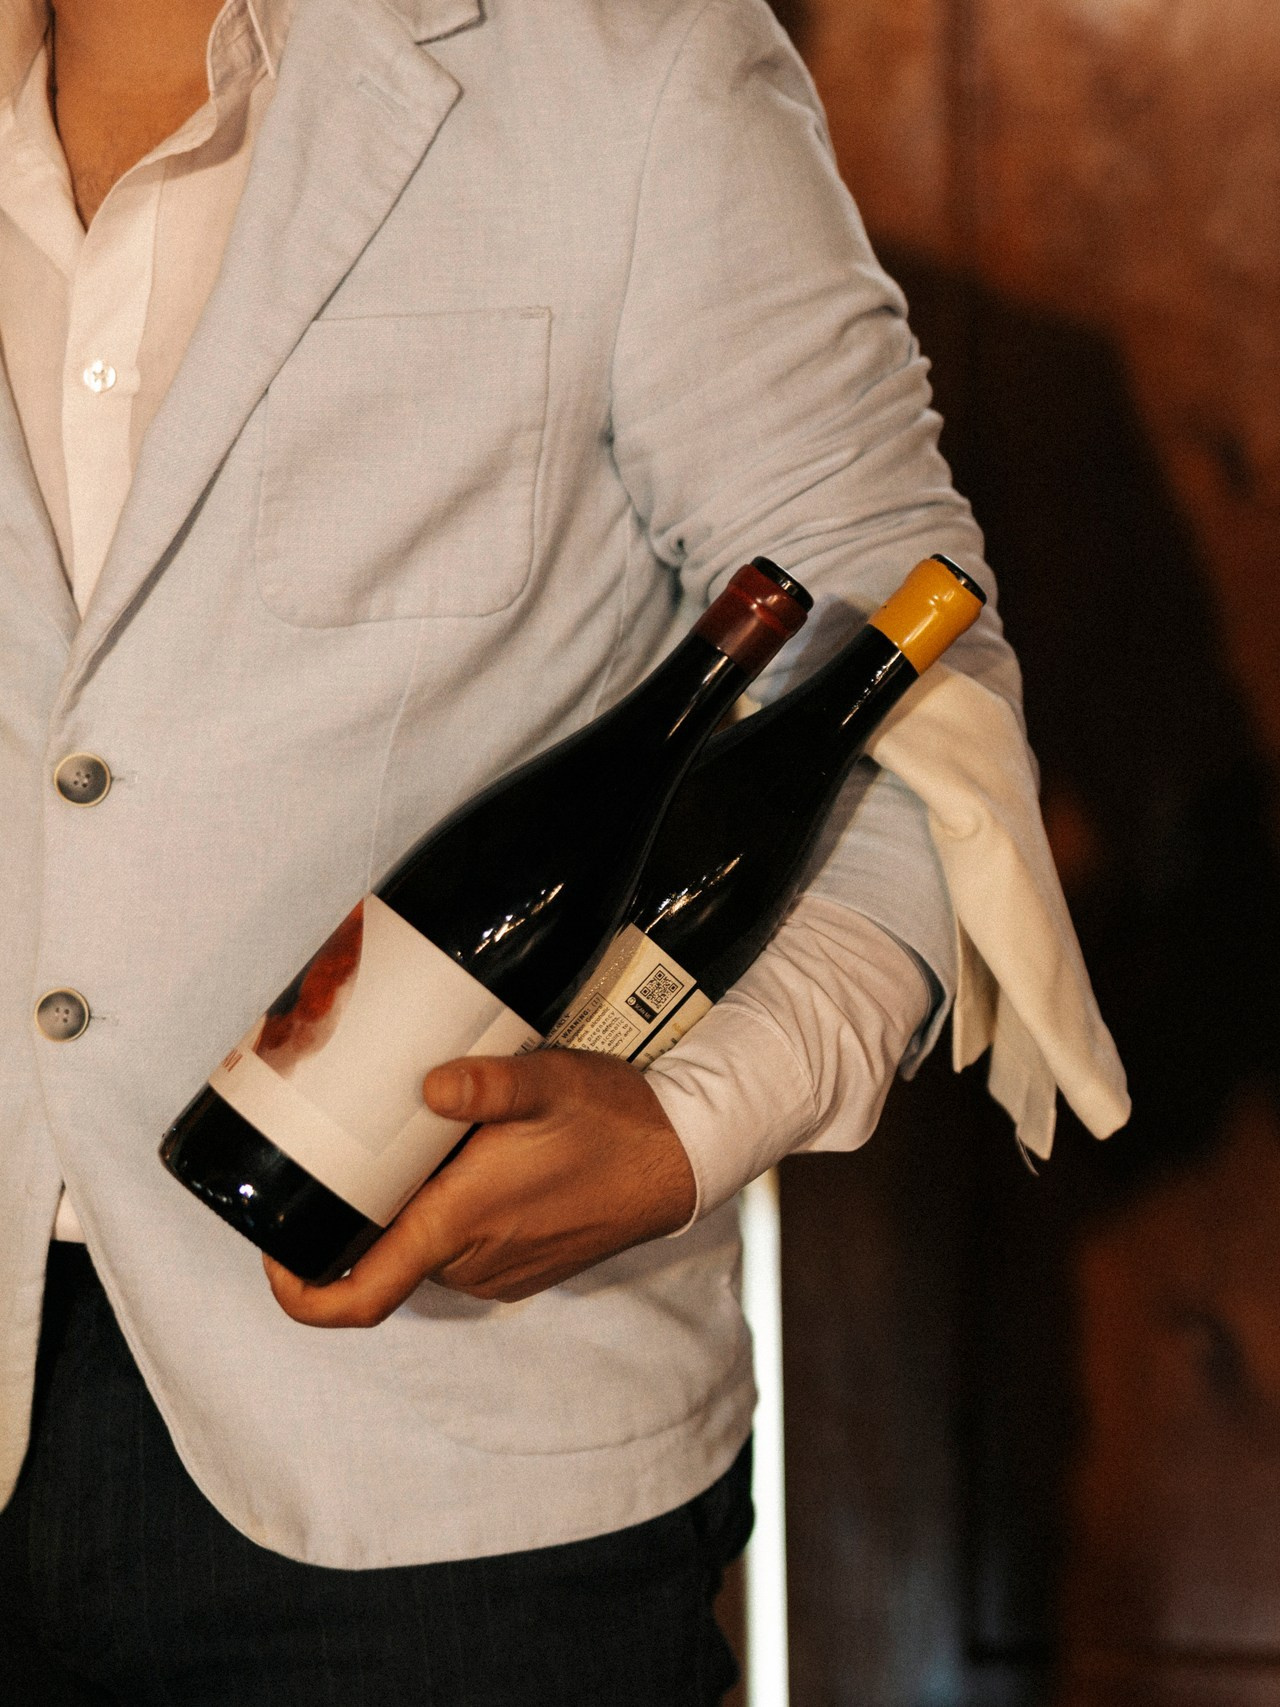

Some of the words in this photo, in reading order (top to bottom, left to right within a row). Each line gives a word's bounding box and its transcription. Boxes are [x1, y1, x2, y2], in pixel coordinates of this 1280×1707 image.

[561, 1007, 591, 1039] WARNING:
[576, 1029, 589, 1042] drink
[589, 1006, 610, 1028] alcoholic
[586, 1010, 616, 1042] pregnancy
[600, 1019, 625, 1045] alcoholic
[622, 1026, 633, 1037] and
[589, 1034, 602, 1047] birth
[606, 1030, 622, 1046] ability
